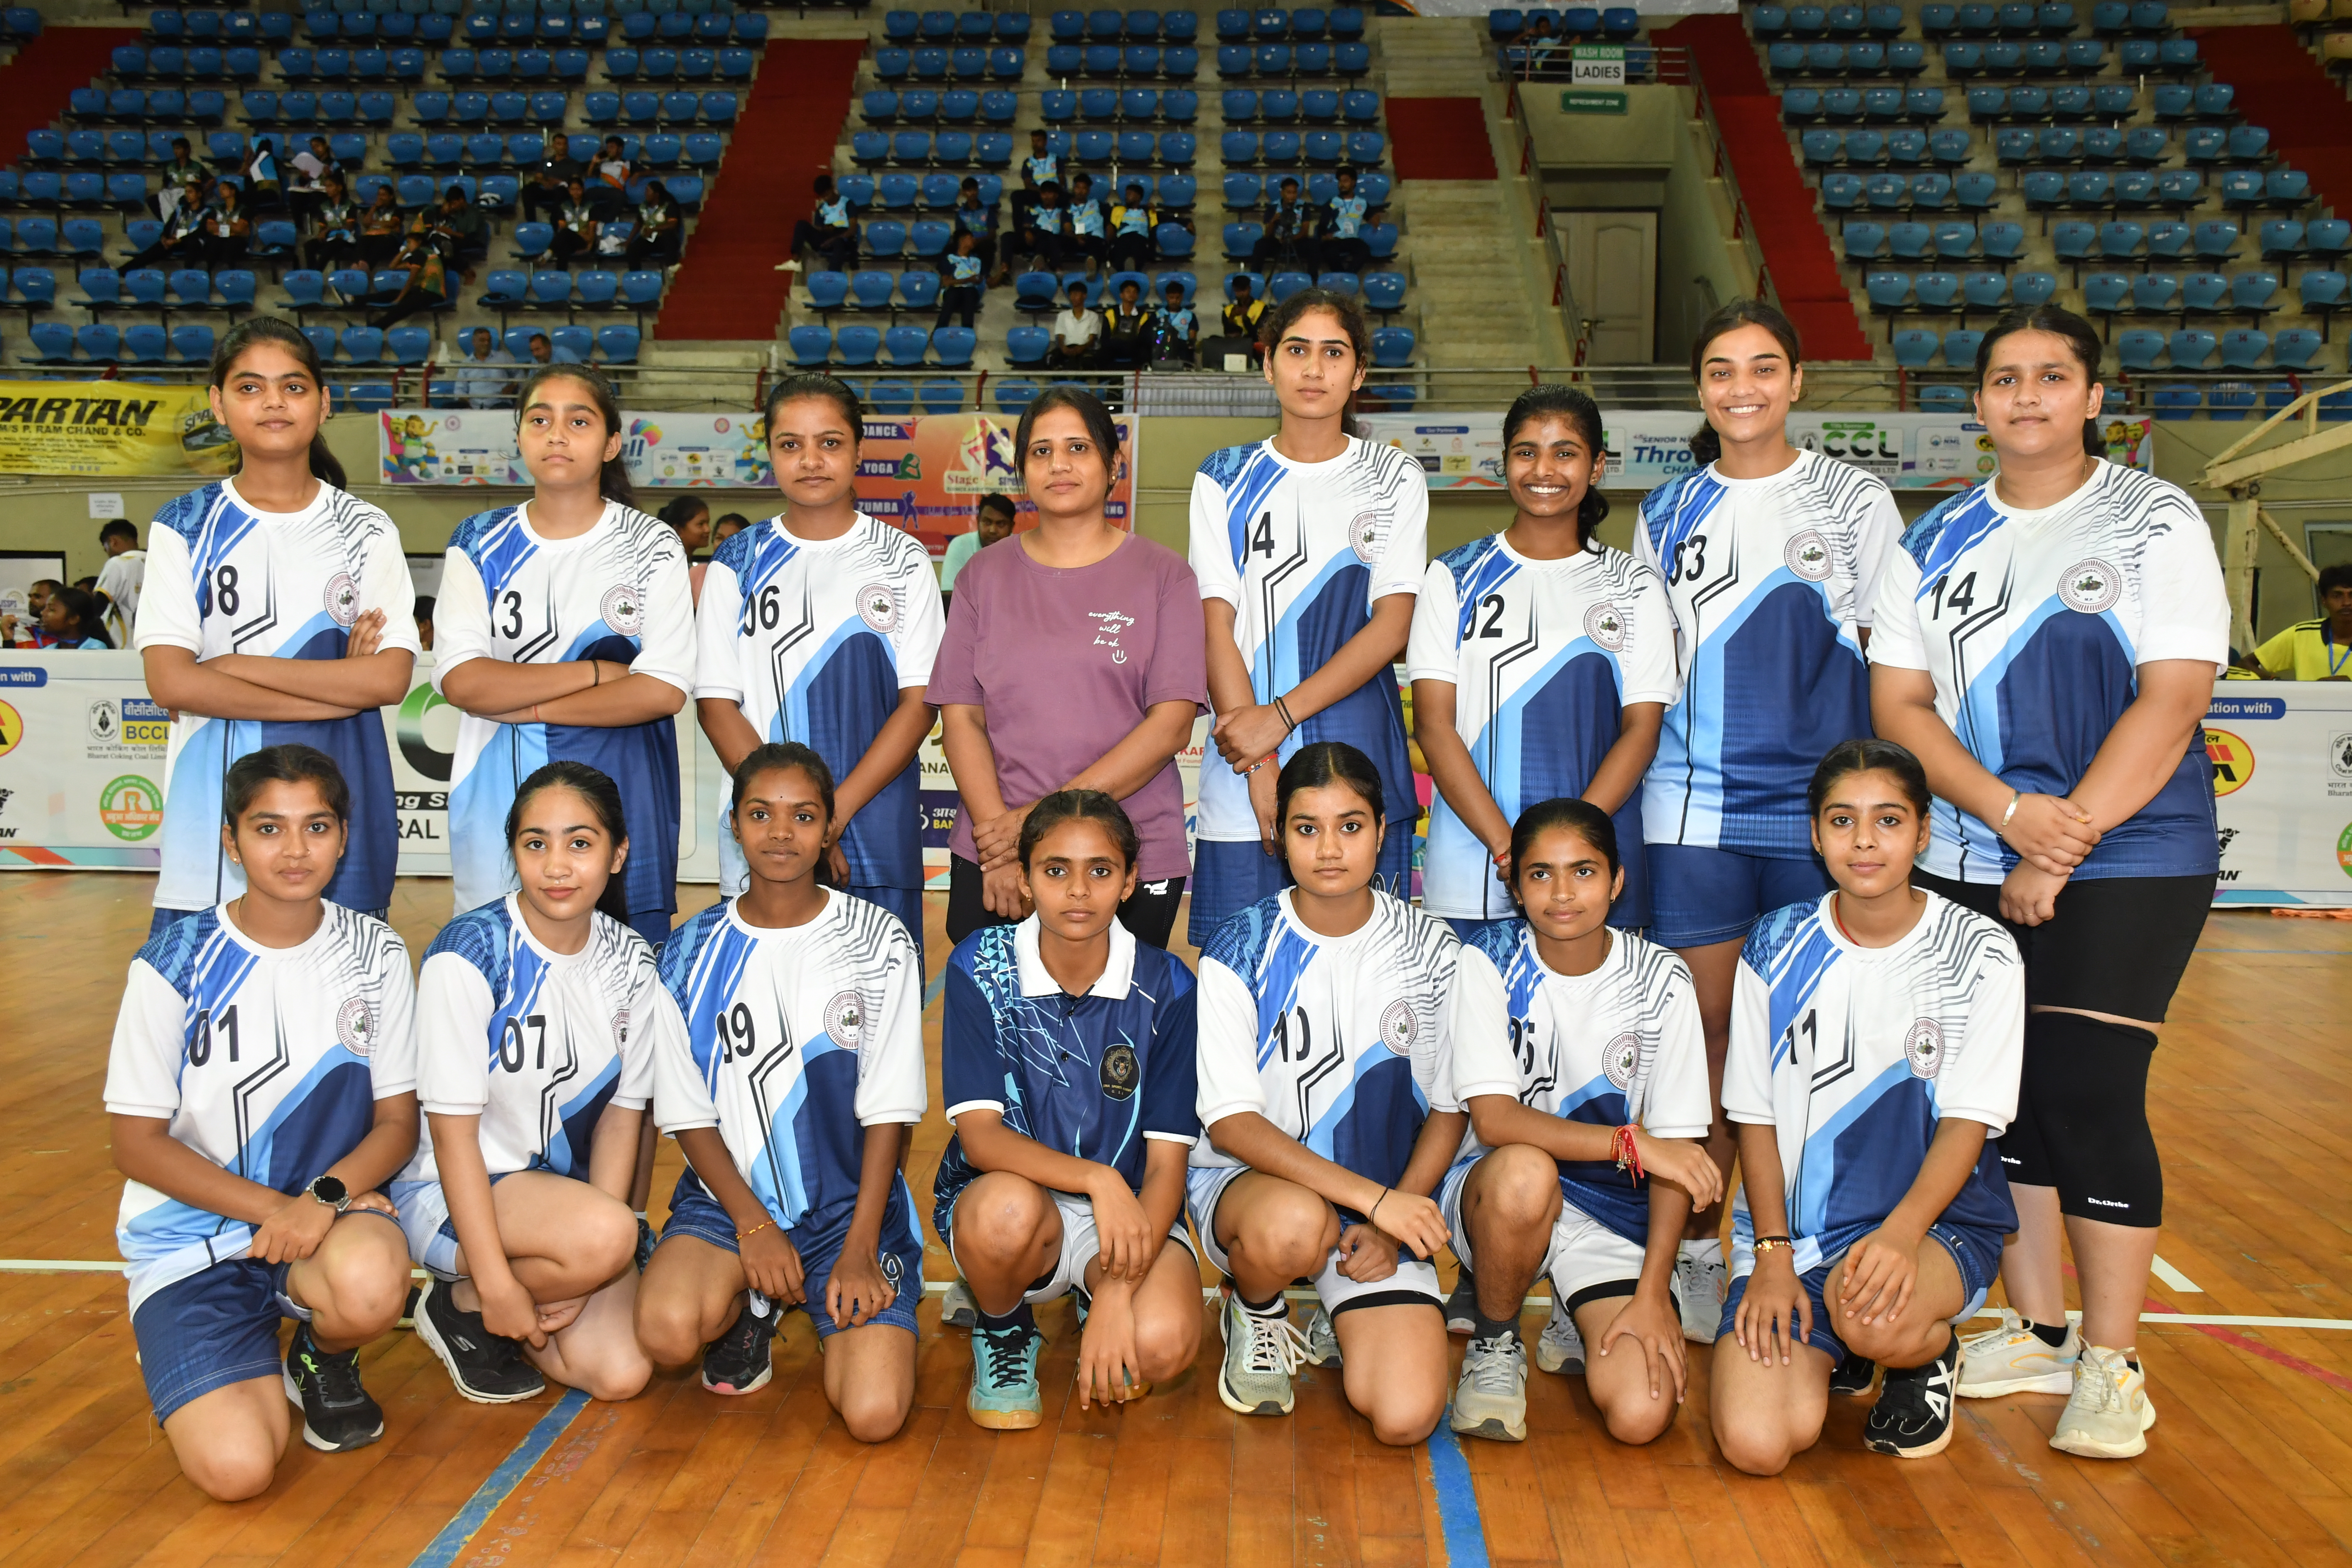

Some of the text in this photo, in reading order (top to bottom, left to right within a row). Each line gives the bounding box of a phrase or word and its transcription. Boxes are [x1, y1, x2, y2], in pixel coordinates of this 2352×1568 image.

[1575, 66, 1620, 79] LADIES
[36, 425, 62, 434] RAM
[66, 426, 109, 436] CHAND
[114, 427, 122, 436] &
[127, 427, 146, 436] CO.
[1823, 431, 1898, 457] CCL
[864, 463, 893, 474] YOGA
[858, 501, 899, 513] ZUMBA
[2070, 569, 2109, 599] AMATURE THROWBALL ASSOCIATION
[1930, 571, 1977, 621] 14
[1088, 611, 1135, 626] everything
[1099, 623, 1121, 634] will
[1093, 635, 1119, 647] be ok
[11, 671, 36, 682] with
[2243, 702, 2272, 714] with
[126, 726, 169, 740] BCCL
[836, 1002, 857, 1034] AMATURE THROWBA
[189, 1004, 240, 1067] 01
[348, 1021, 359, 1041] AMATURE
[1392, 1022, 1402, 1042] AMATURE
[499, 1015, 546, 1073] 07
[1615, 1055, 1625, 1076] AMATURE
